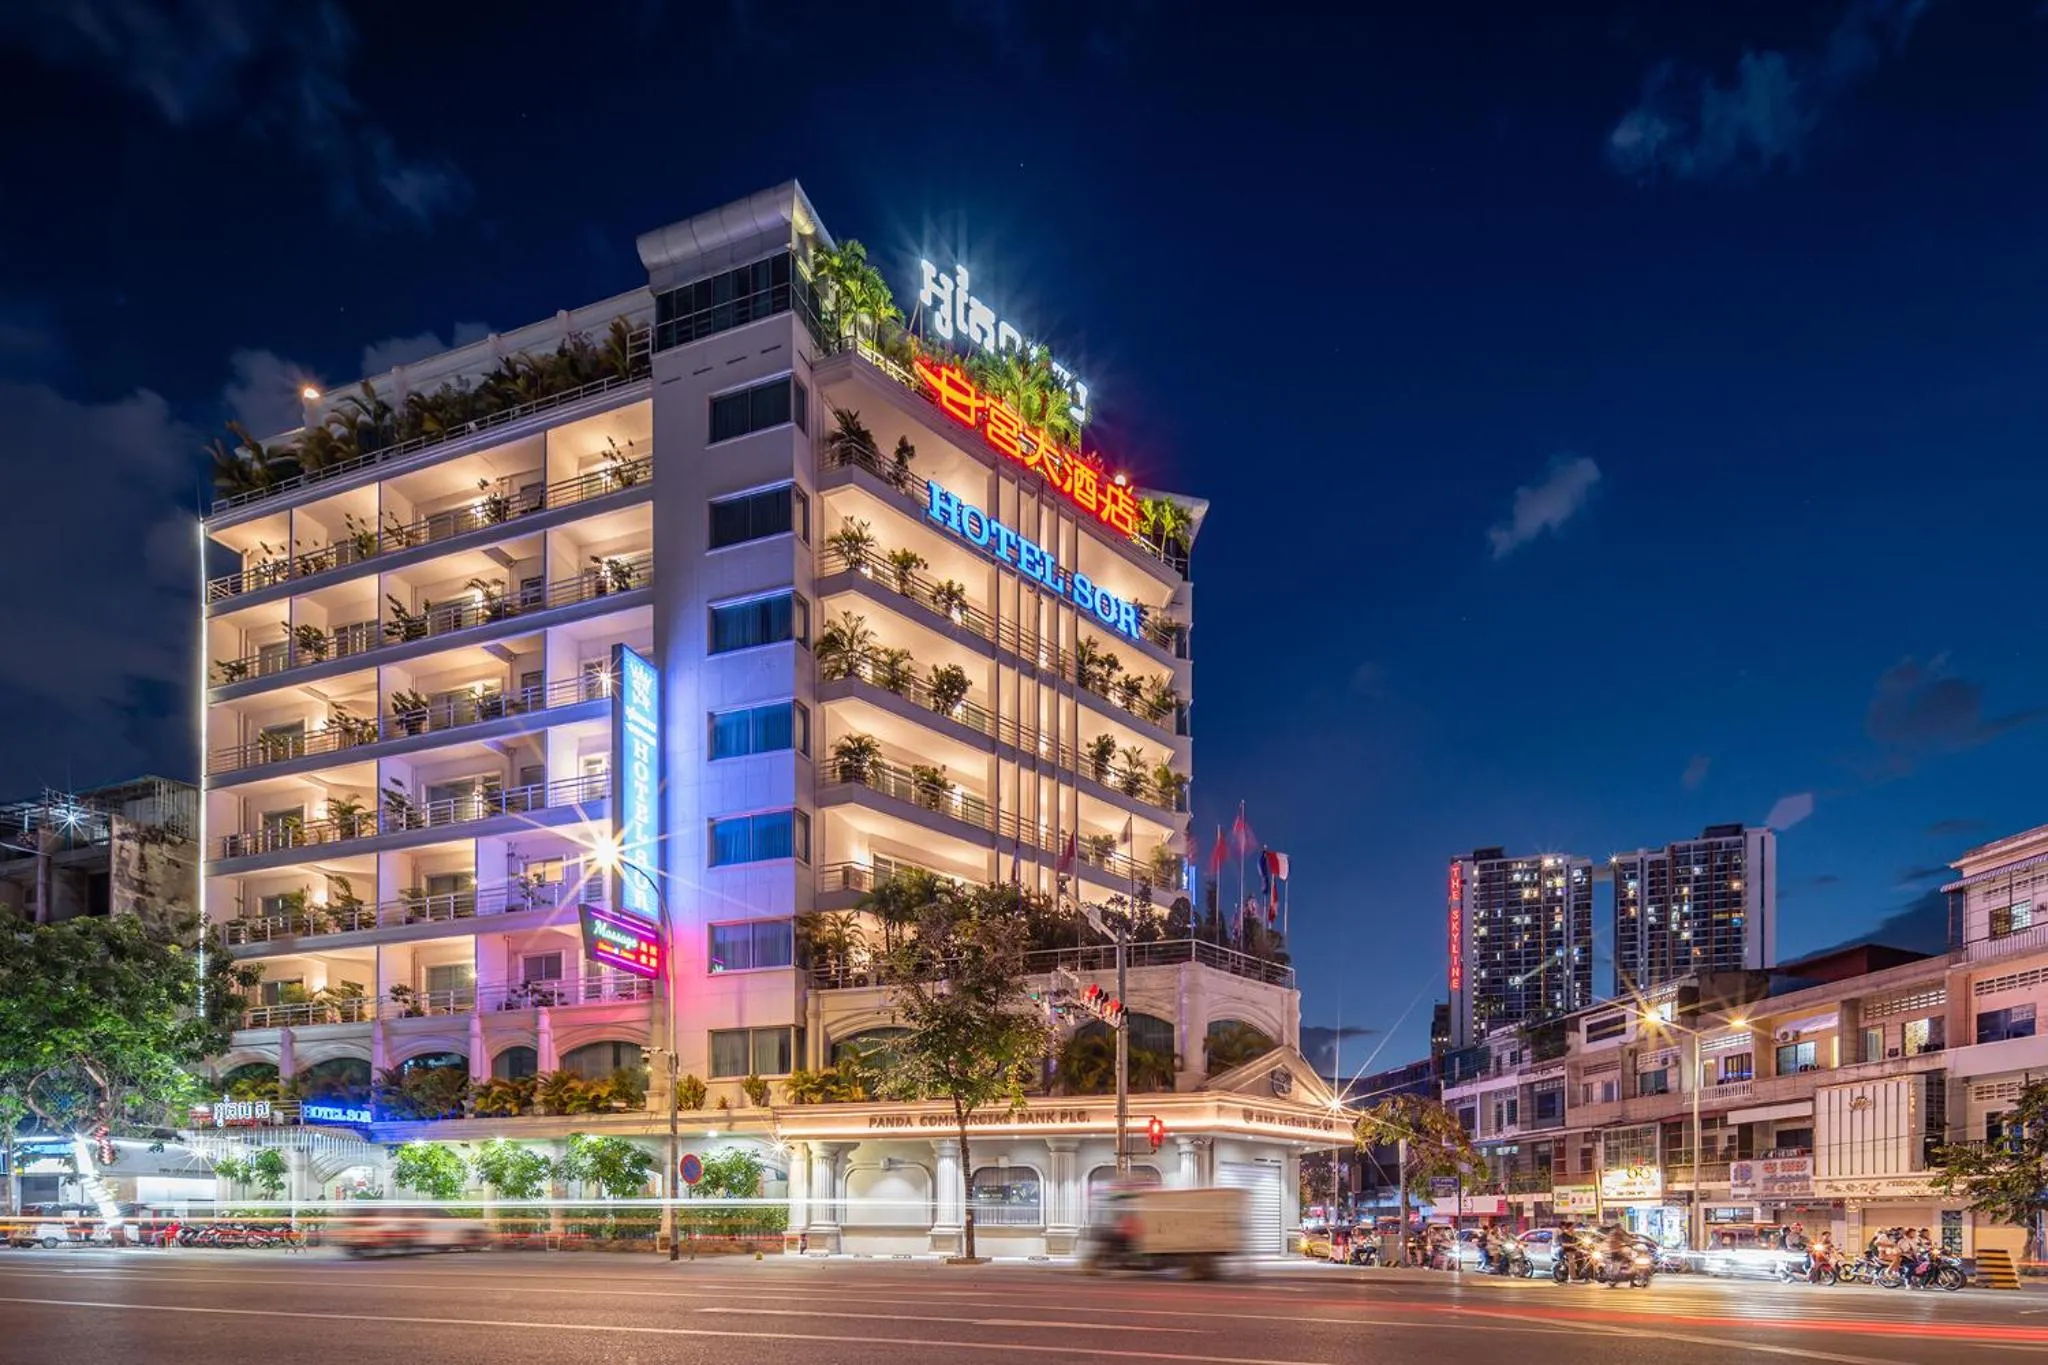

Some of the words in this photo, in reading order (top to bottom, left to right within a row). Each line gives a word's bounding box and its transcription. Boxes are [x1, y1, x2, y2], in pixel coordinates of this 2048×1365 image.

[927, 479, 1067, 595] HOTEL
[1072, 572, 1140, 640] SOR
[633, 738, 650, 843] HOTEL
[1450, 866, 1461, 900] THE
[592, 919, 639, 950] Massage
[1450, 910, 1461, 989] SKYLINE
[303, 1105, 346, 1121] HOTEL
[346, 1109, 372, 1123] SOR
[868, 1115, 913, 1128] PANDA
[1017, 1111, 1056, 1124] BANK
